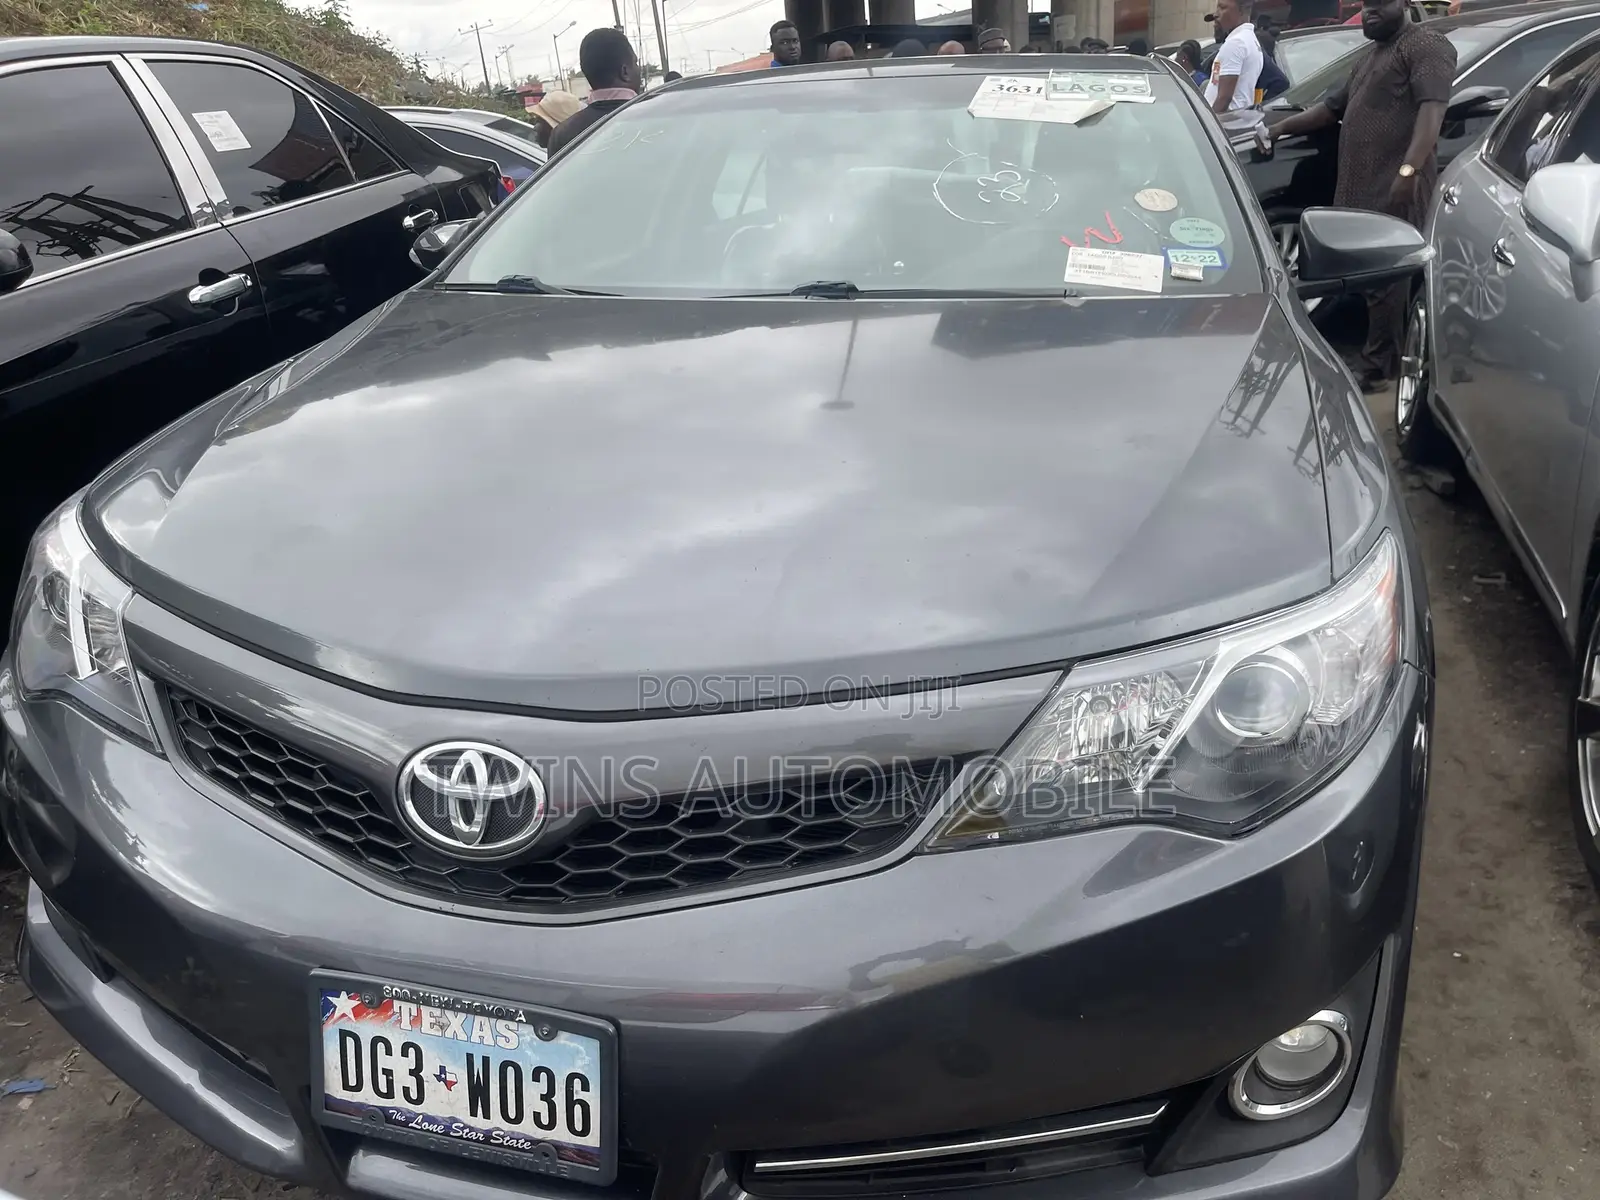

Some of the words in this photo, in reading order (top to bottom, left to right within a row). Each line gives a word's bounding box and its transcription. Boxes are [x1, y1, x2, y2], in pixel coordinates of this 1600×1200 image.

[991, 84, 1044, 95] 3631
[1051, 83, 1146, 95] LAGOS
[1200, 254, 1219, 264] 22
[393, 1000, 520, 1051] TEXAS
[338, 1028, 425, 1107] DG3
[465, 1052, 592, 1138] W036
[388, 1109, 407, 1122] The
[409, 1114, 445, 1134] Lone
[449, 1122, 486, 1142] Star
[490, 1131, 533, 1150] State
